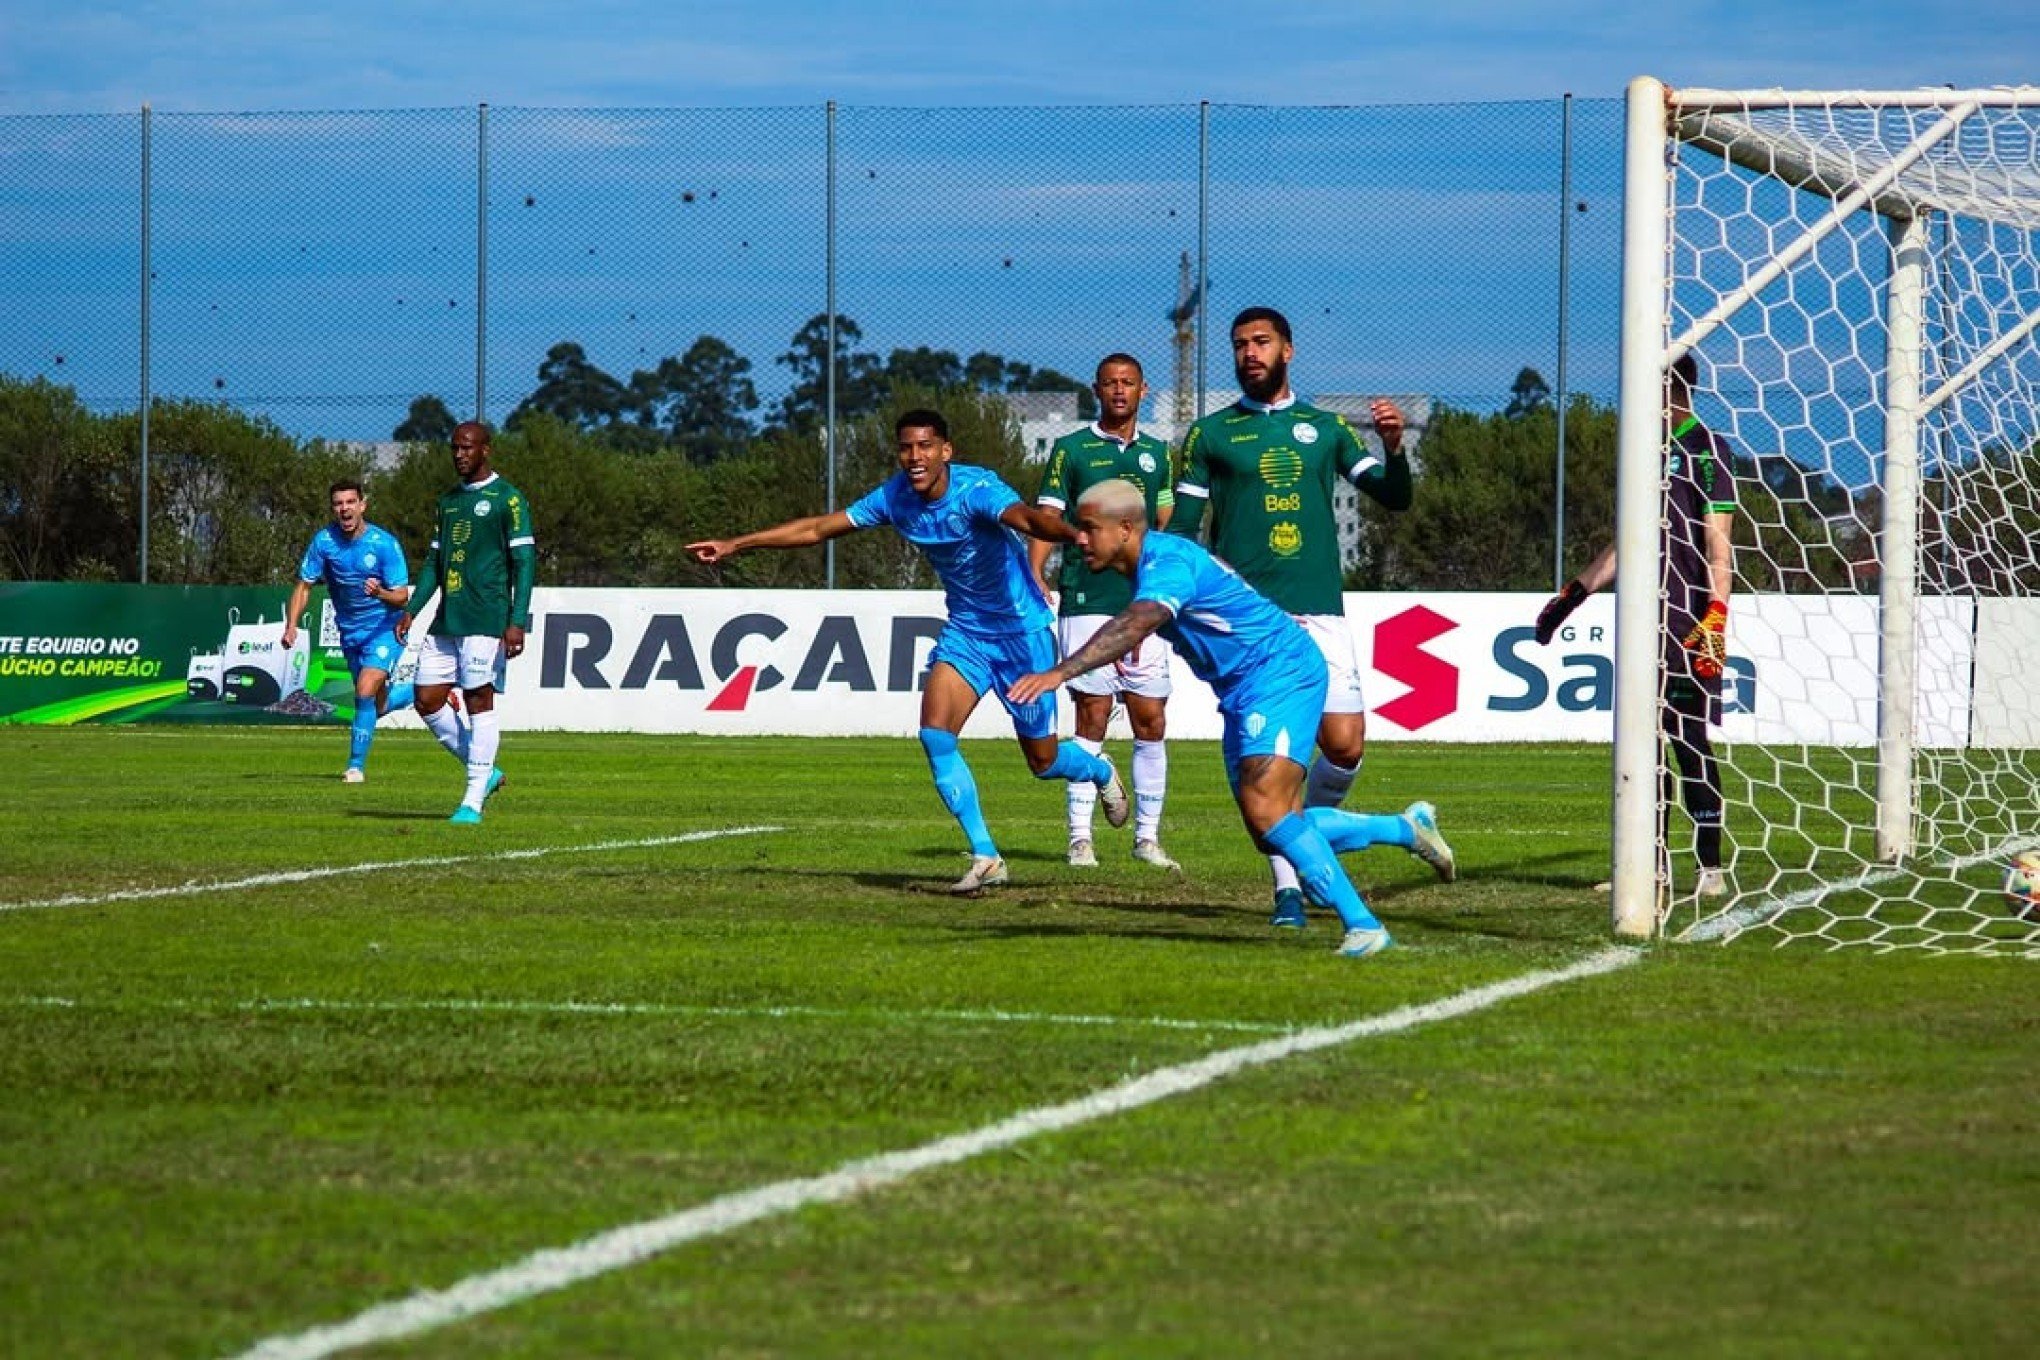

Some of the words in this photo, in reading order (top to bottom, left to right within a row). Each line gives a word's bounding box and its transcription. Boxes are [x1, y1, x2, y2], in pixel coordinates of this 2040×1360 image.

[1264, 493, 1300, 512] Be8
[1561, 626, 1605, 642] GR
[26, 637, 105, 654] EQUIBIO
[109, 638, 139, 655] NO
[1, 655, 56, 676] ÚCHO
[60, 656, 162, 677] CAMPEÃO!
[1487, 624, 1757, 714] Saa
